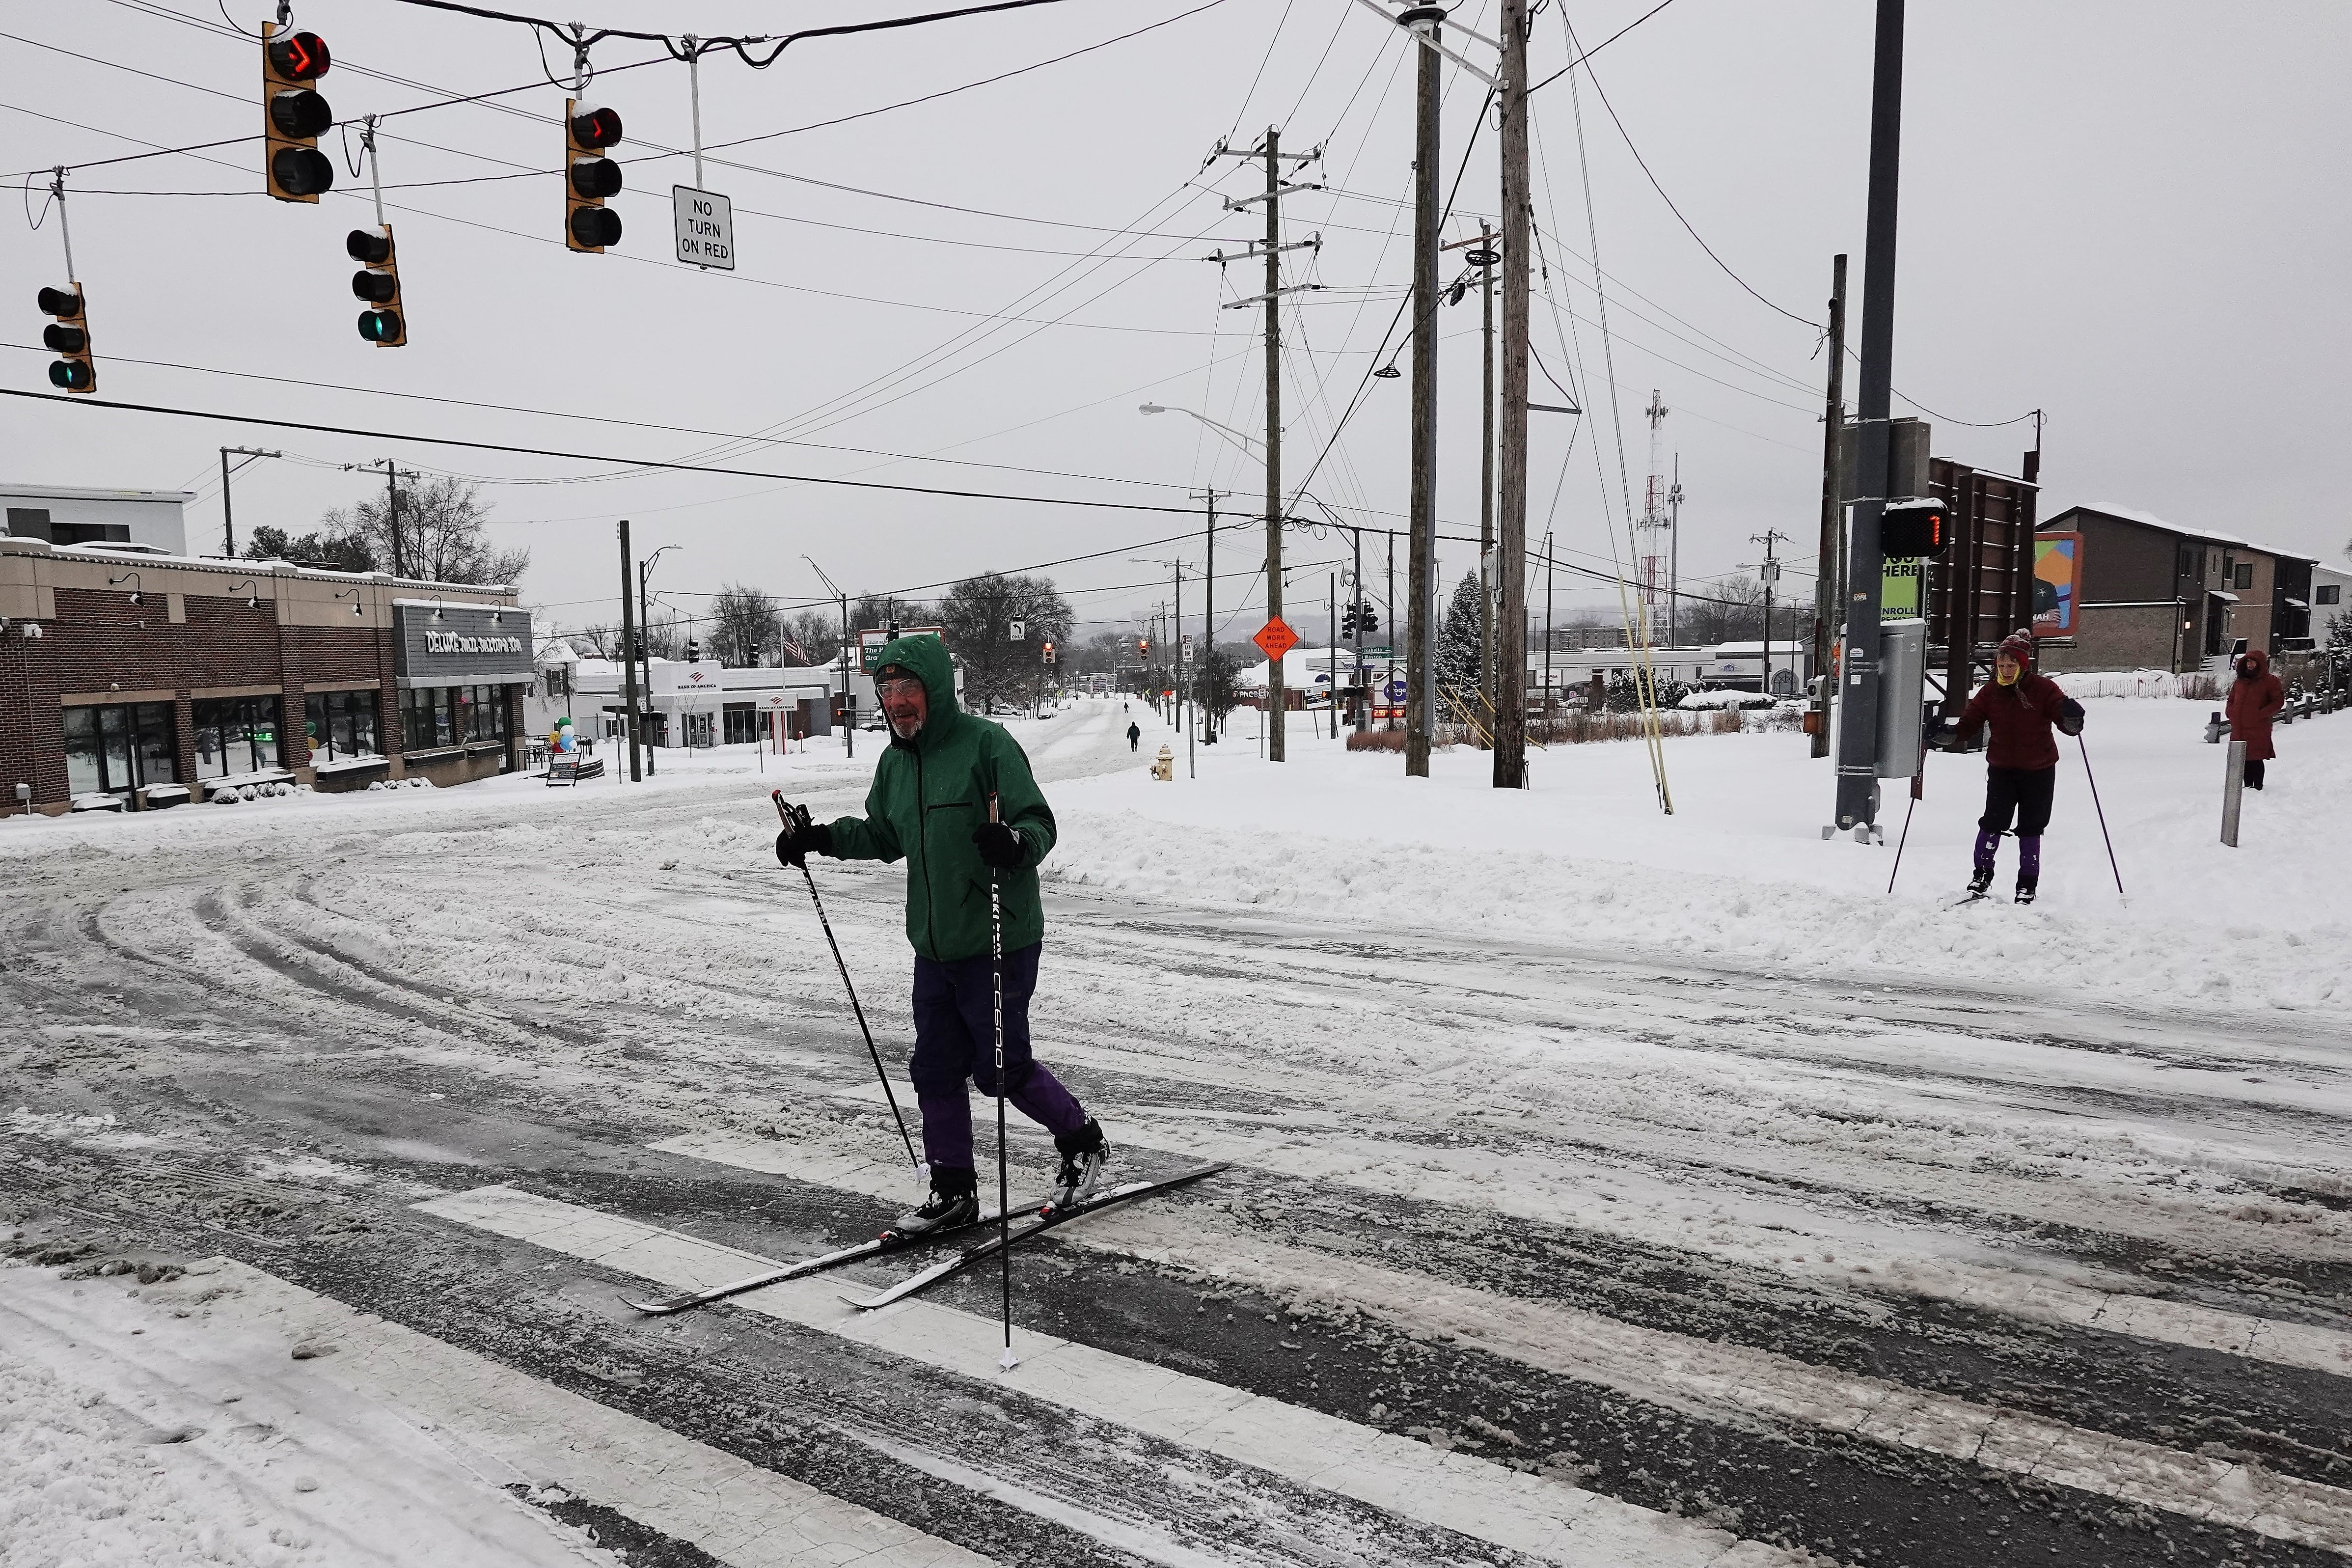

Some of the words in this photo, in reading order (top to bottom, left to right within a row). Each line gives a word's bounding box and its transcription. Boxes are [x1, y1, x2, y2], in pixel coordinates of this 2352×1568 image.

[693, 199, 712, 216] NO
[688, 219, 721, 238] TURN
[682, 238, 699, 254] ON
[705, 242, 728, 259] RED
